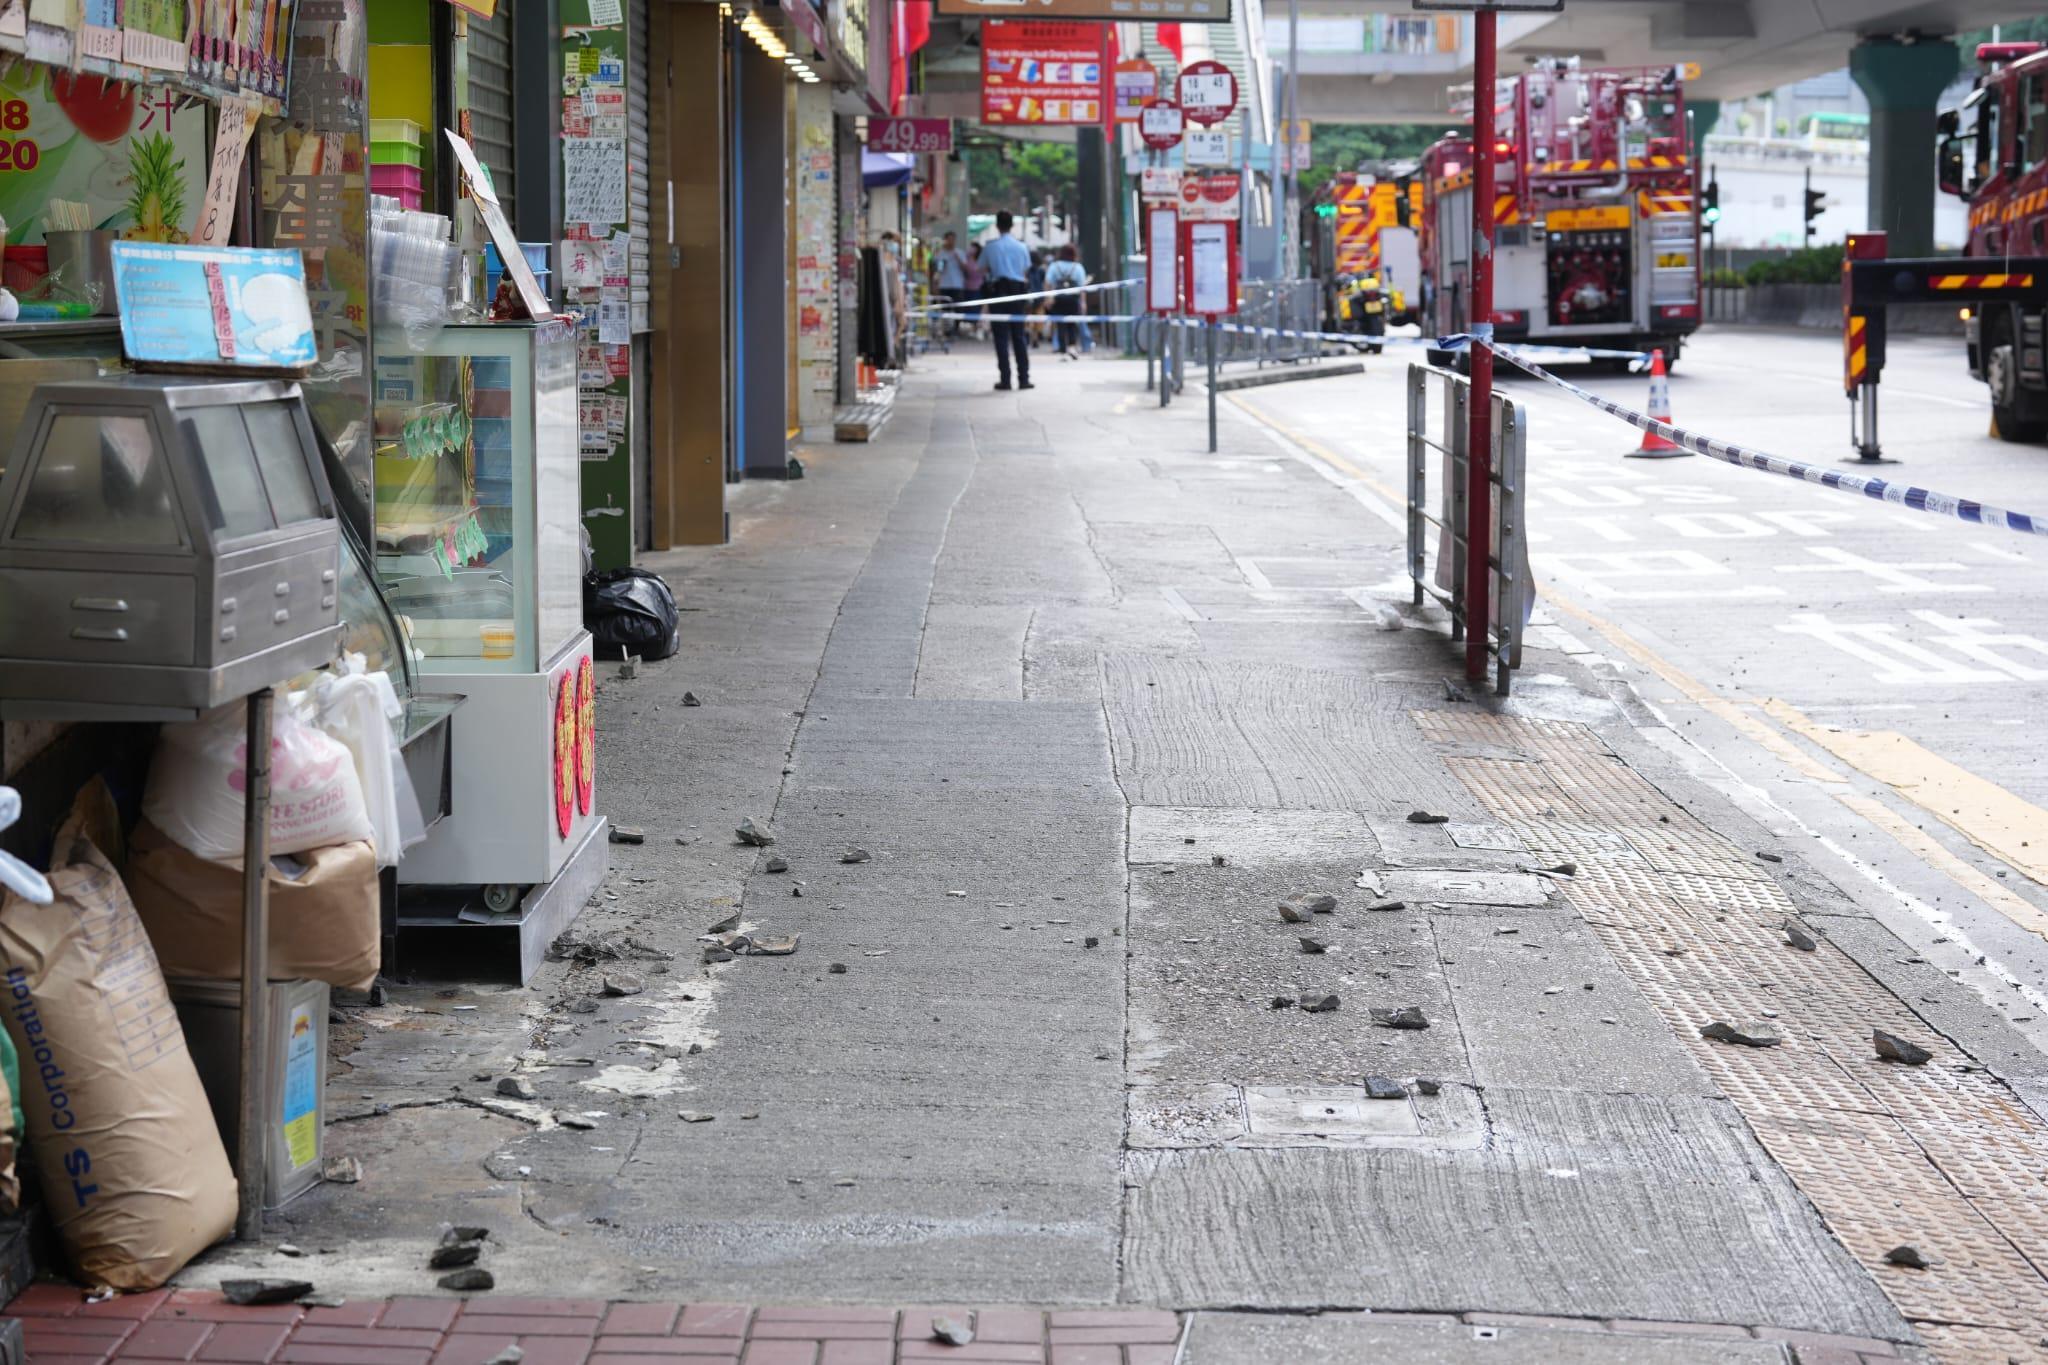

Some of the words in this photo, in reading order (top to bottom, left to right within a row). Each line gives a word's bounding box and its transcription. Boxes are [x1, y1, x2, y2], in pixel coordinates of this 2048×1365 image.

[139, 88, 175, 133] 汁
[882, 119, 940, 150] 49.99
[0, 139, 39, 171] 20
[1525, 484, 1738, 508] US
[272, 803, 295, 819] TE
[299, 786, 344, 814] STOR
[7, 966, 76, 1131] Corporation
[64, 1147, 100, 1208] TS
